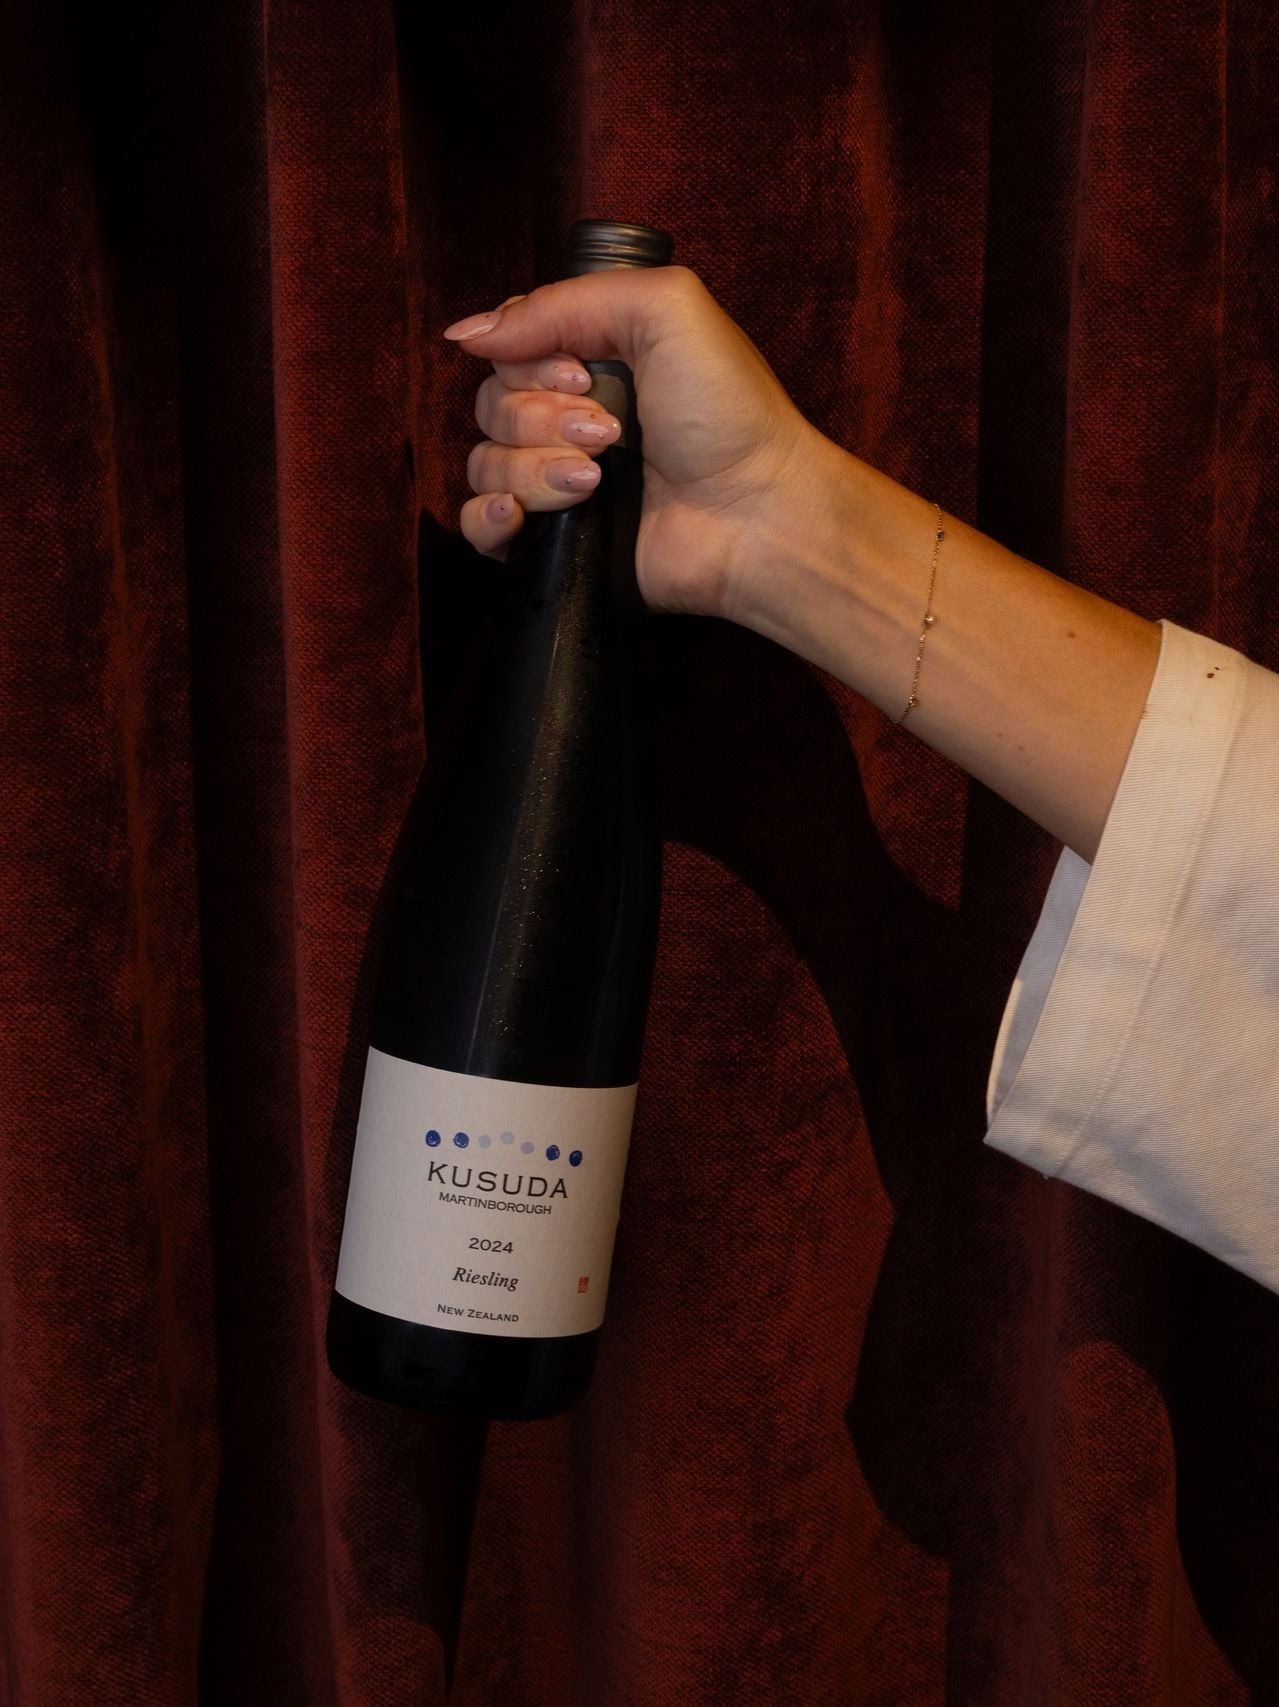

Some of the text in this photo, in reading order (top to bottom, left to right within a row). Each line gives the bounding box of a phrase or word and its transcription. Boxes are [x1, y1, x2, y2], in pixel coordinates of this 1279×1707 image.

[427, 1160, 568, 1199] KUSUDA
[438, 1191, 552, 1215] MARTINBOROUGH
[468, 1237, 514, 1254] 2024
[452, 1266, 519, 1292] Riesling
[437, 1303, 520, 1323] NEW ZEALAND
